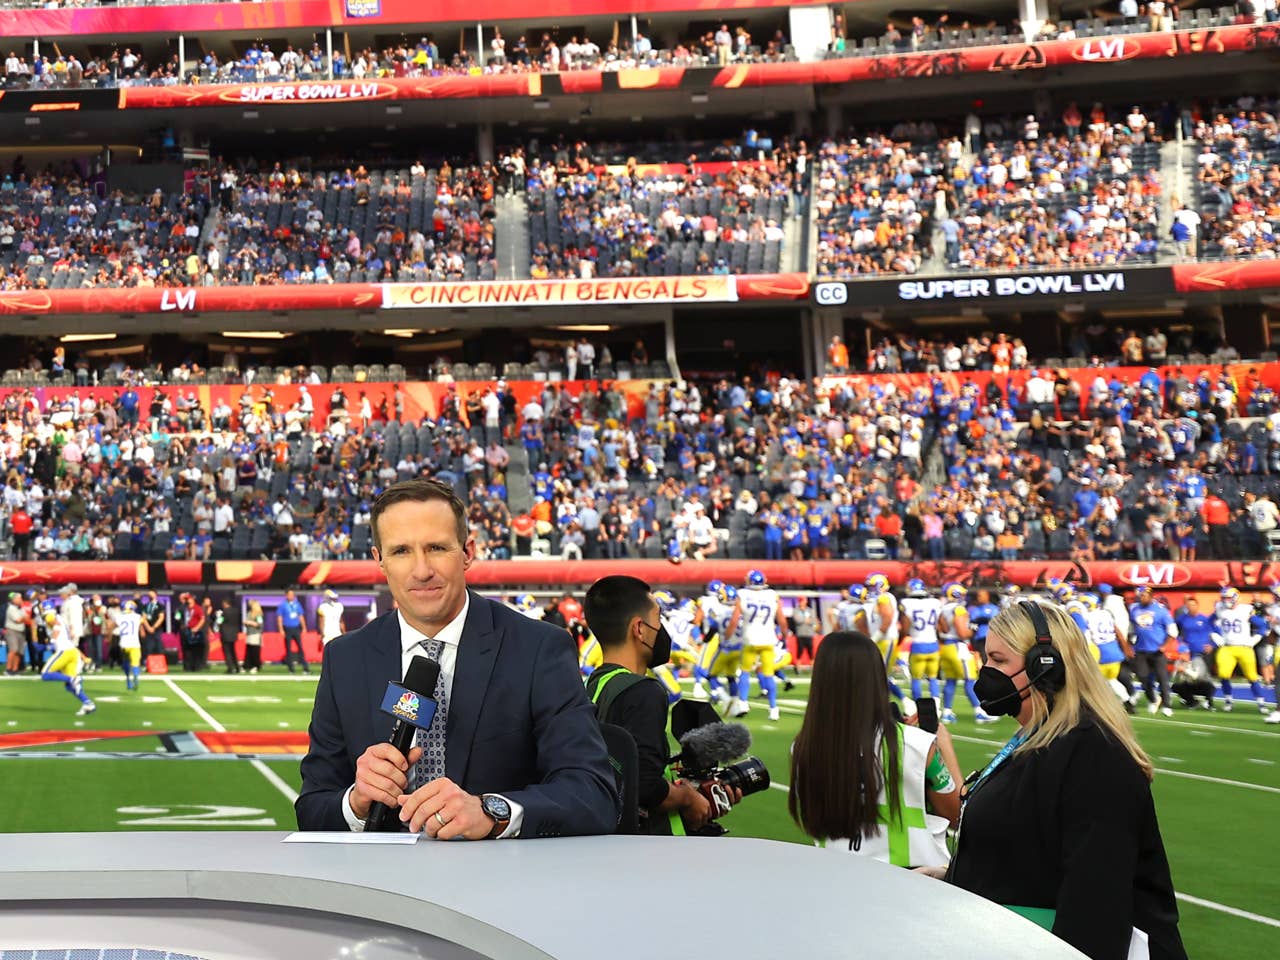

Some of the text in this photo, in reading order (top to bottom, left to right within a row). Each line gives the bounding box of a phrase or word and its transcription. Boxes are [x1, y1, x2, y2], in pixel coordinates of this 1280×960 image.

[1082, 39, 1126, 60] LVI
[240, 83, 379, 102] SUPER BOWL LVI
[410, 279, 709, 305] CINCINNATI BENGALS
[898, 273, 1125, 300] SUPER BOWL LVI
[161, 289, 197, 311] LVI
[1129, 563, 1177, 585] LVI
[747, 603, 771, 625] 77
[912, 608, 938, 631] 54
[120, 621, 135, 636] 21
[397, 700, 419, 716] NBC
[116, 804, 277, 826] 2
